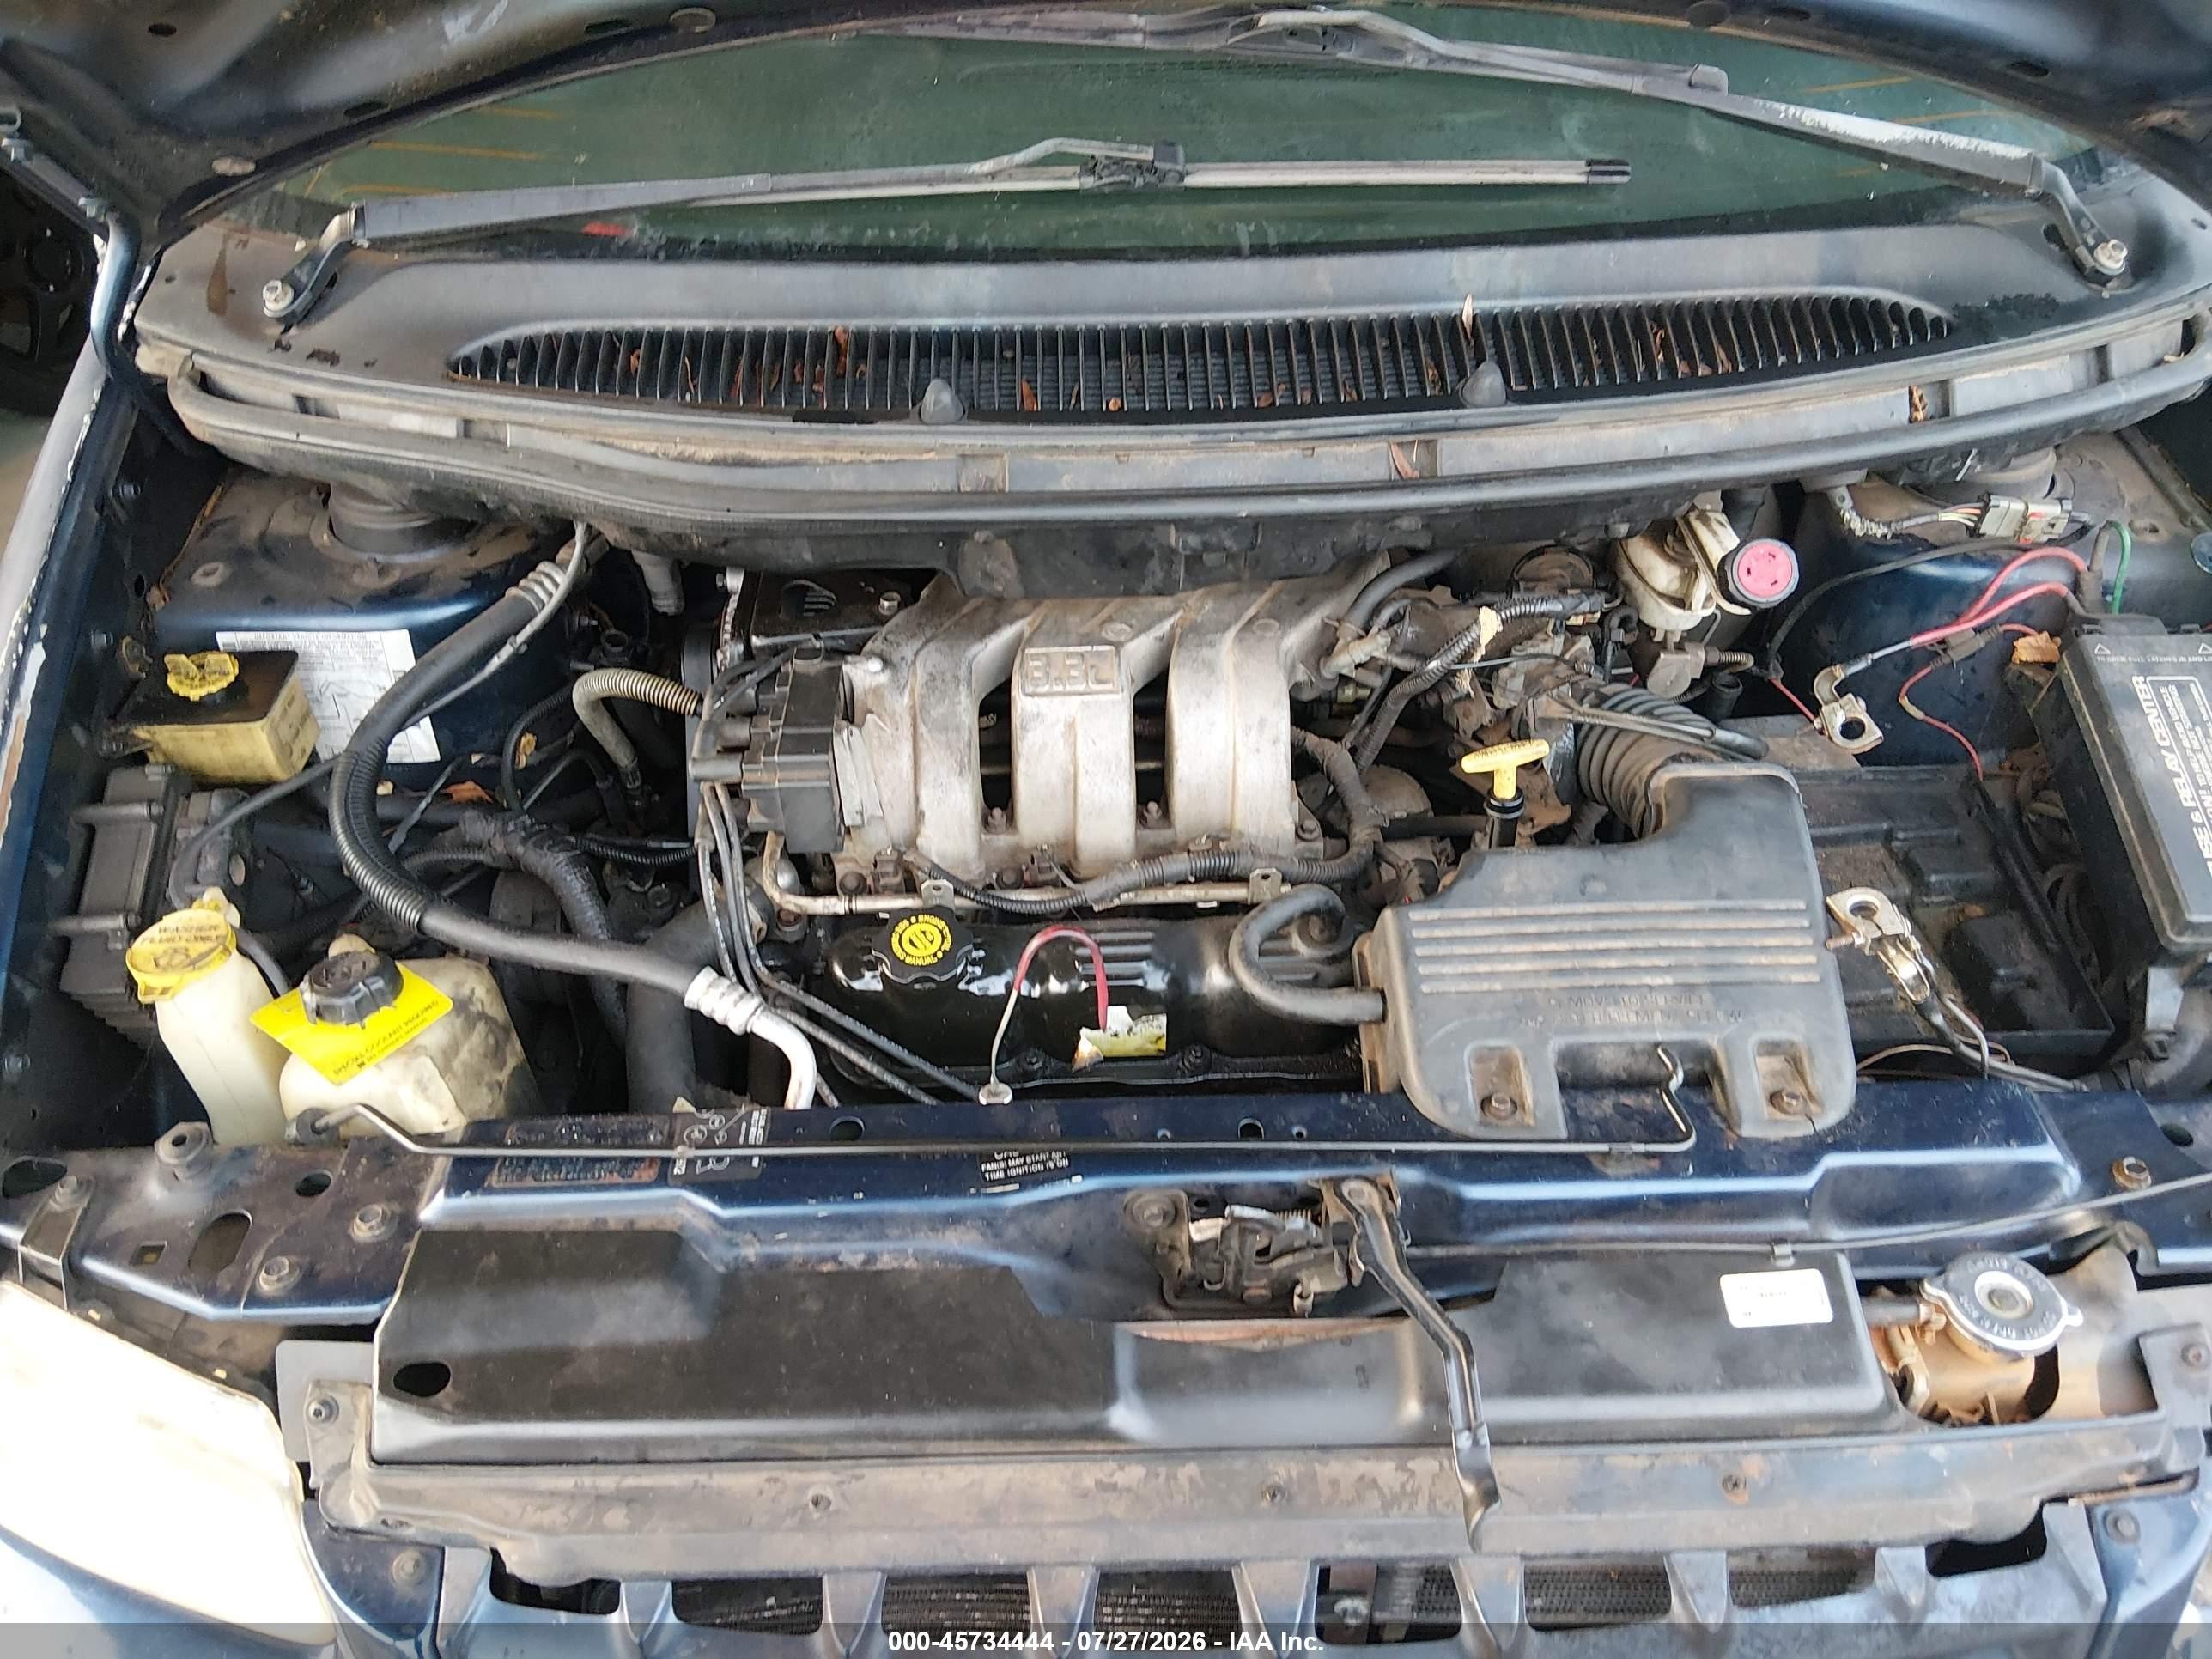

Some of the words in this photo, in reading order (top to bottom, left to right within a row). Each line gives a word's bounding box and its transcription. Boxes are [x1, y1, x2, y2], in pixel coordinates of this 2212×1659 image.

[1030, 652, 1114, 693] 3.3L
[2132, 676, 2171, 747] CENTER
[2160, 749, 2197, 807] RELAY
[905, 954, 939, 966] MANUAL
[985, 1170, 1006, 1182] TIME
[1006, 1162, 1044, 1178] IGNITION
[1046, 1160, 1054, 1171] IS
[1055, 1158, 1070, 1169] ON
[1008, 1156, 1024, 1168] MAY
[1025, 1152, 1049, 1163] START
